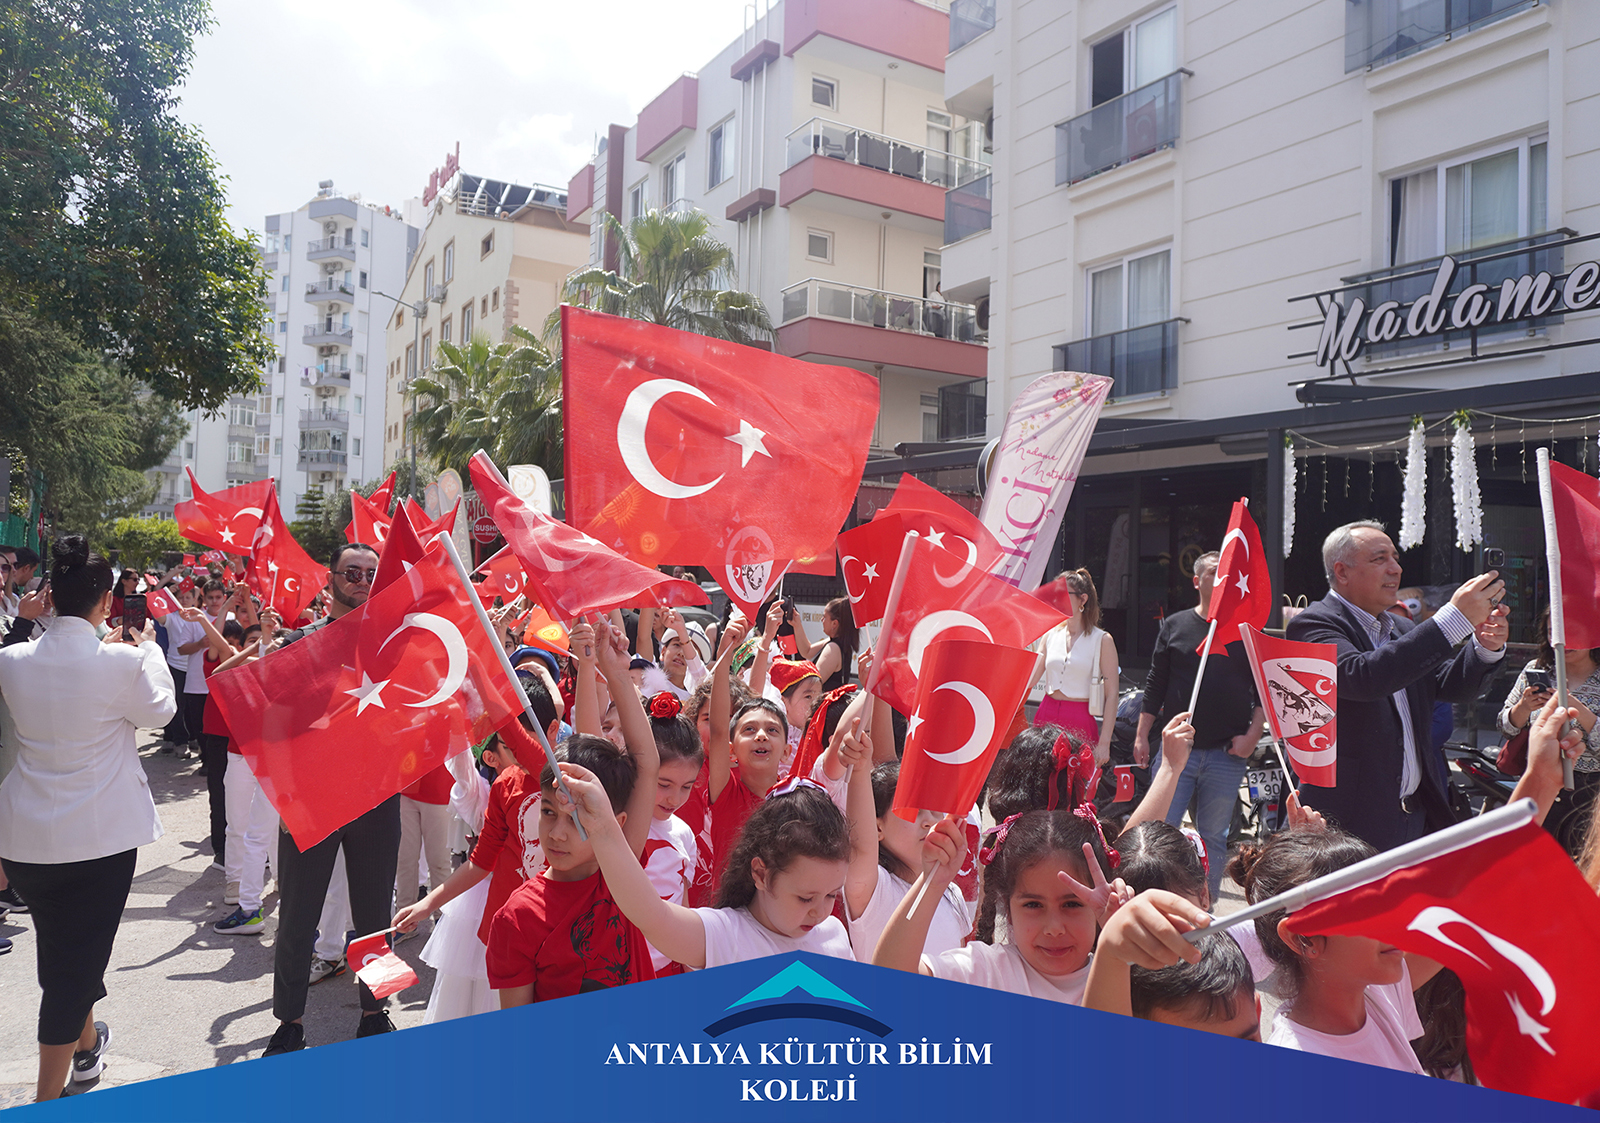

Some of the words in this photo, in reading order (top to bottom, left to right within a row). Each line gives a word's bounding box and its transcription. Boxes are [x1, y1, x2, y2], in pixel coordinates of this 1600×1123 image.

[1316, 254, 1600, 367] Madame
[1001, 438, 1059, 460] Madame
[475, 524, 497, 532] SUSHI
[988, 476, 1056, 588] EKÇİ
[1250, 771, 1267, 784] 32
